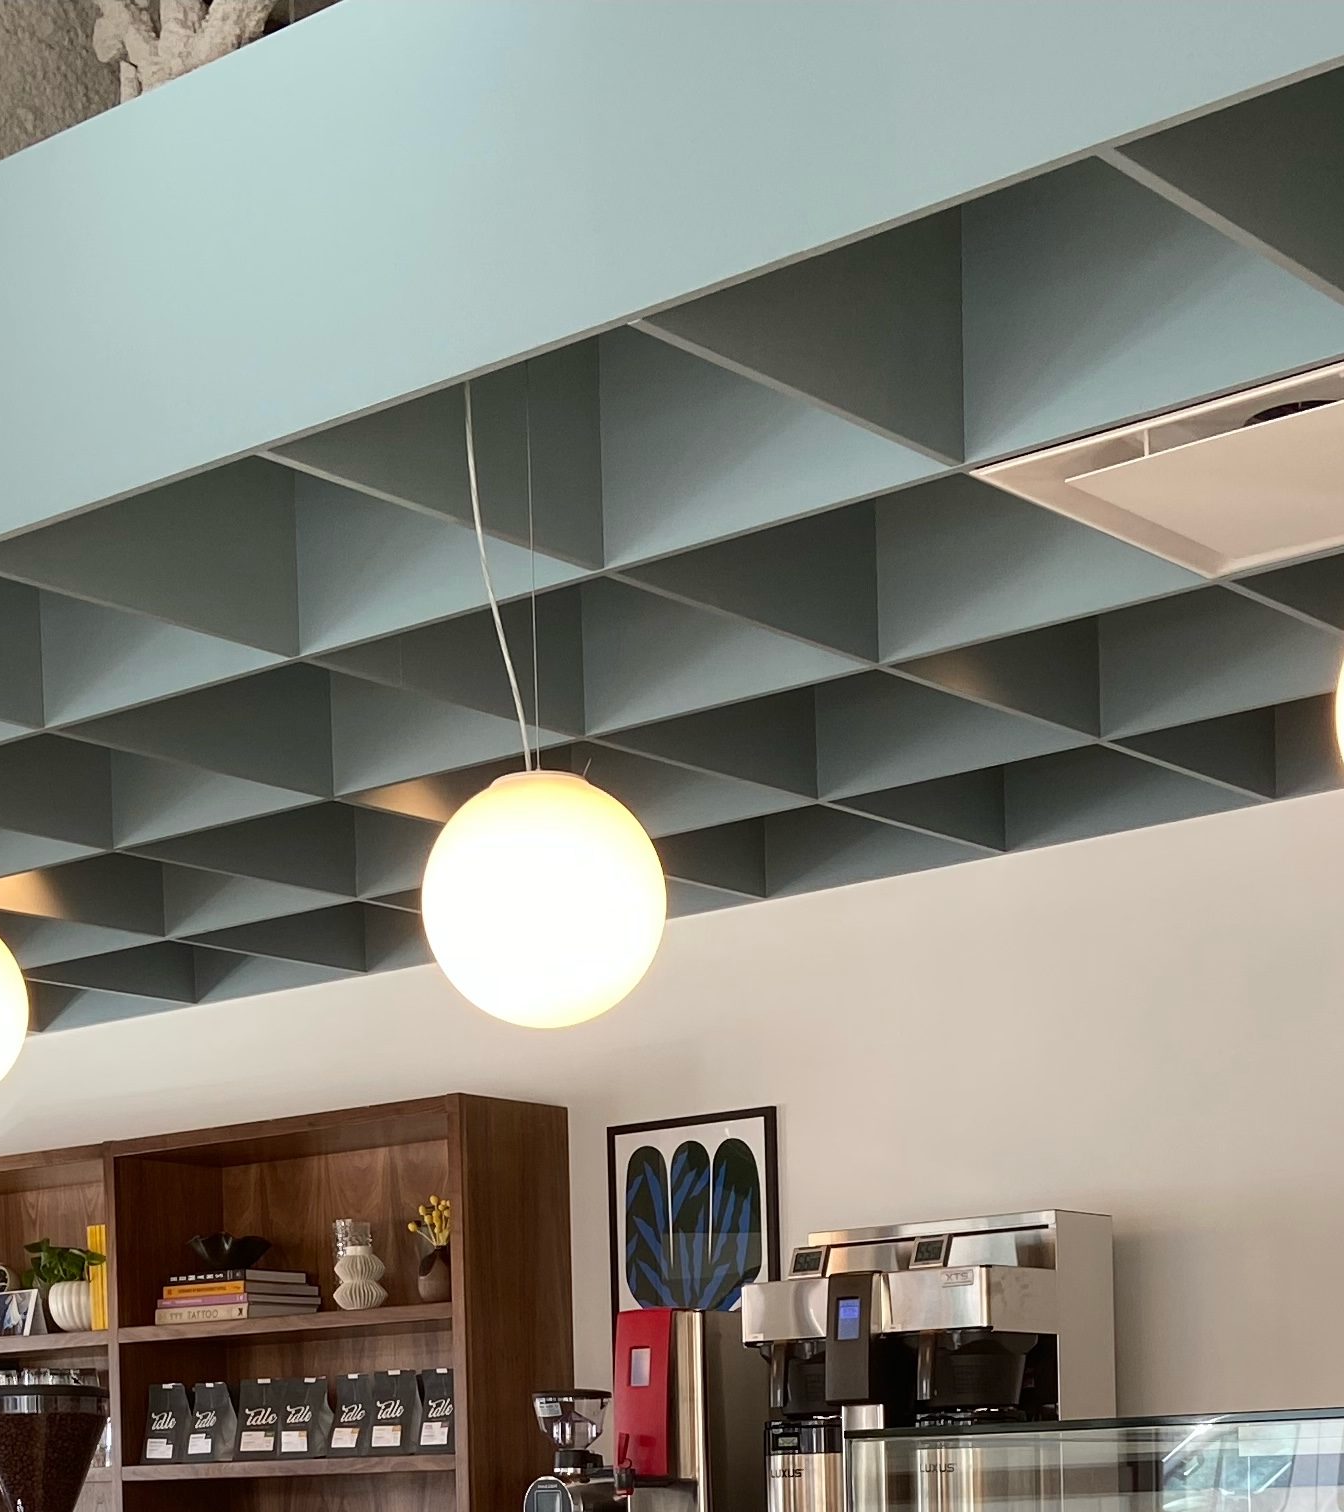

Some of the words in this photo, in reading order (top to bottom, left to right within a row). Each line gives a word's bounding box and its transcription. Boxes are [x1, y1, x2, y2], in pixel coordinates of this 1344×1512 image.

[945, 1272, 968, 1281] XTS
[187, 1310, 218, 1320] TATTOO
[920, 1463, 955, 1473] LUXUS
[770, 1469, 803, 1478] LUXUS
